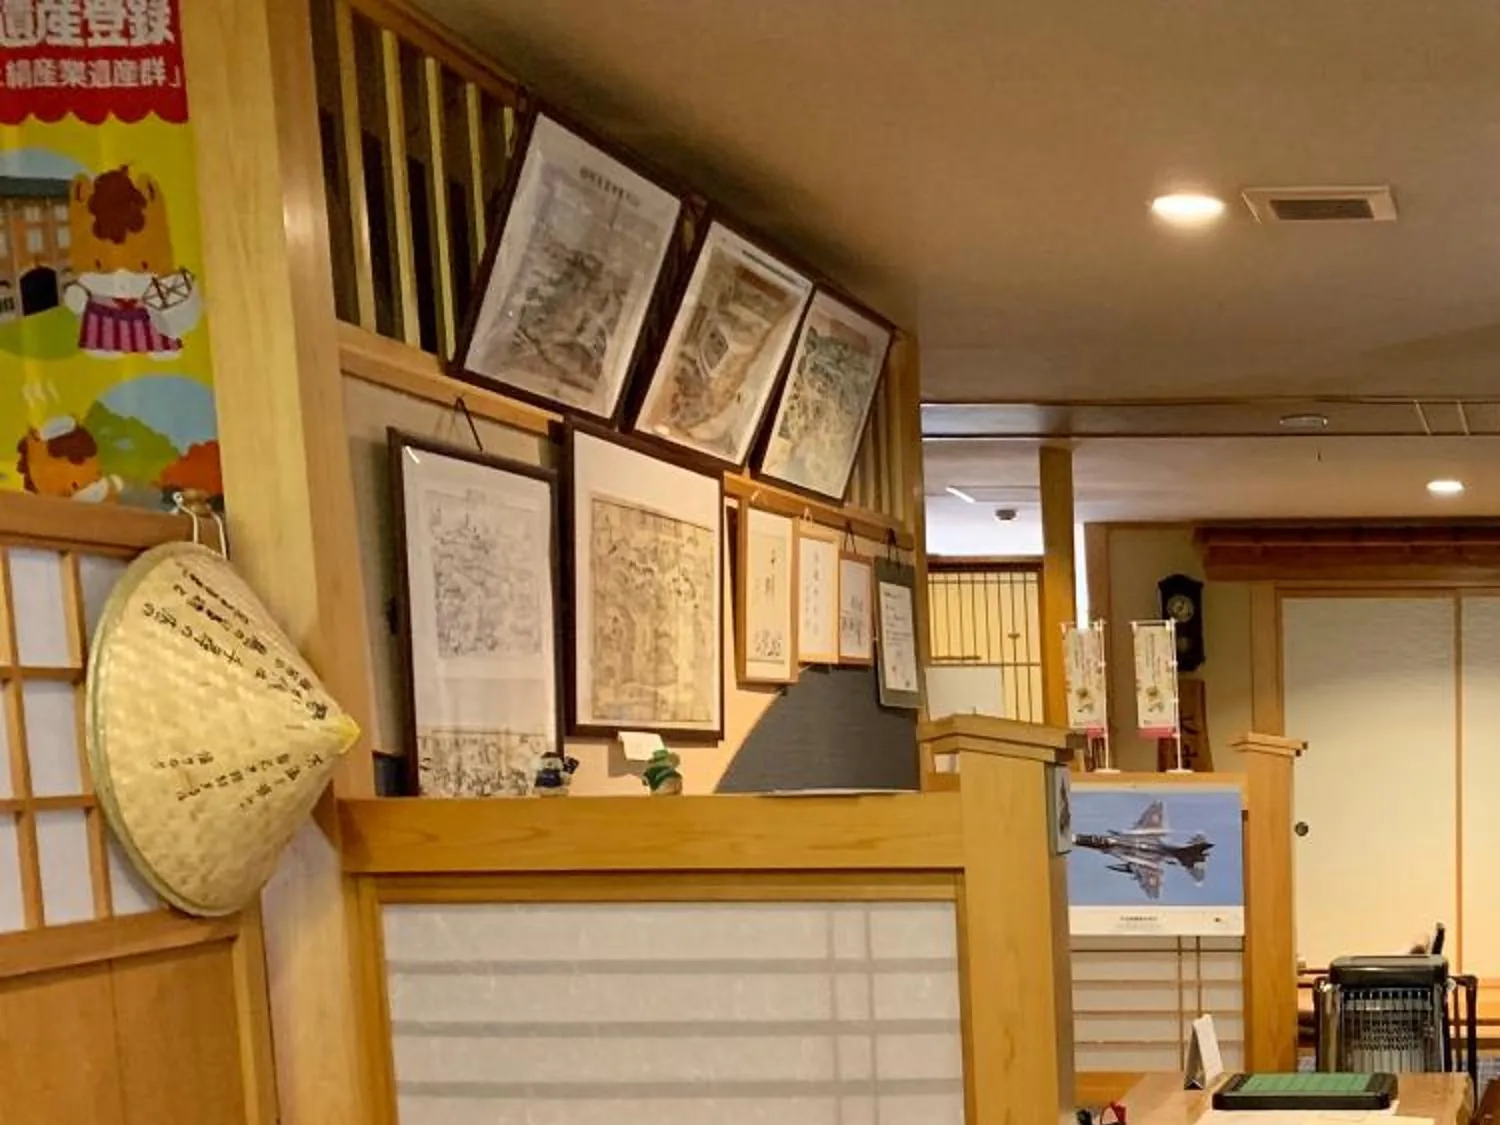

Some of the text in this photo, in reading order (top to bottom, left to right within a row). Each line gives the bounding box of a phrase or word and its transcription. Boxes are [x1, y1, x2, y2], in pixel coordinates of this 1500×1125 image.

[0, 56, 182, 89] 絹産業遺産群」
